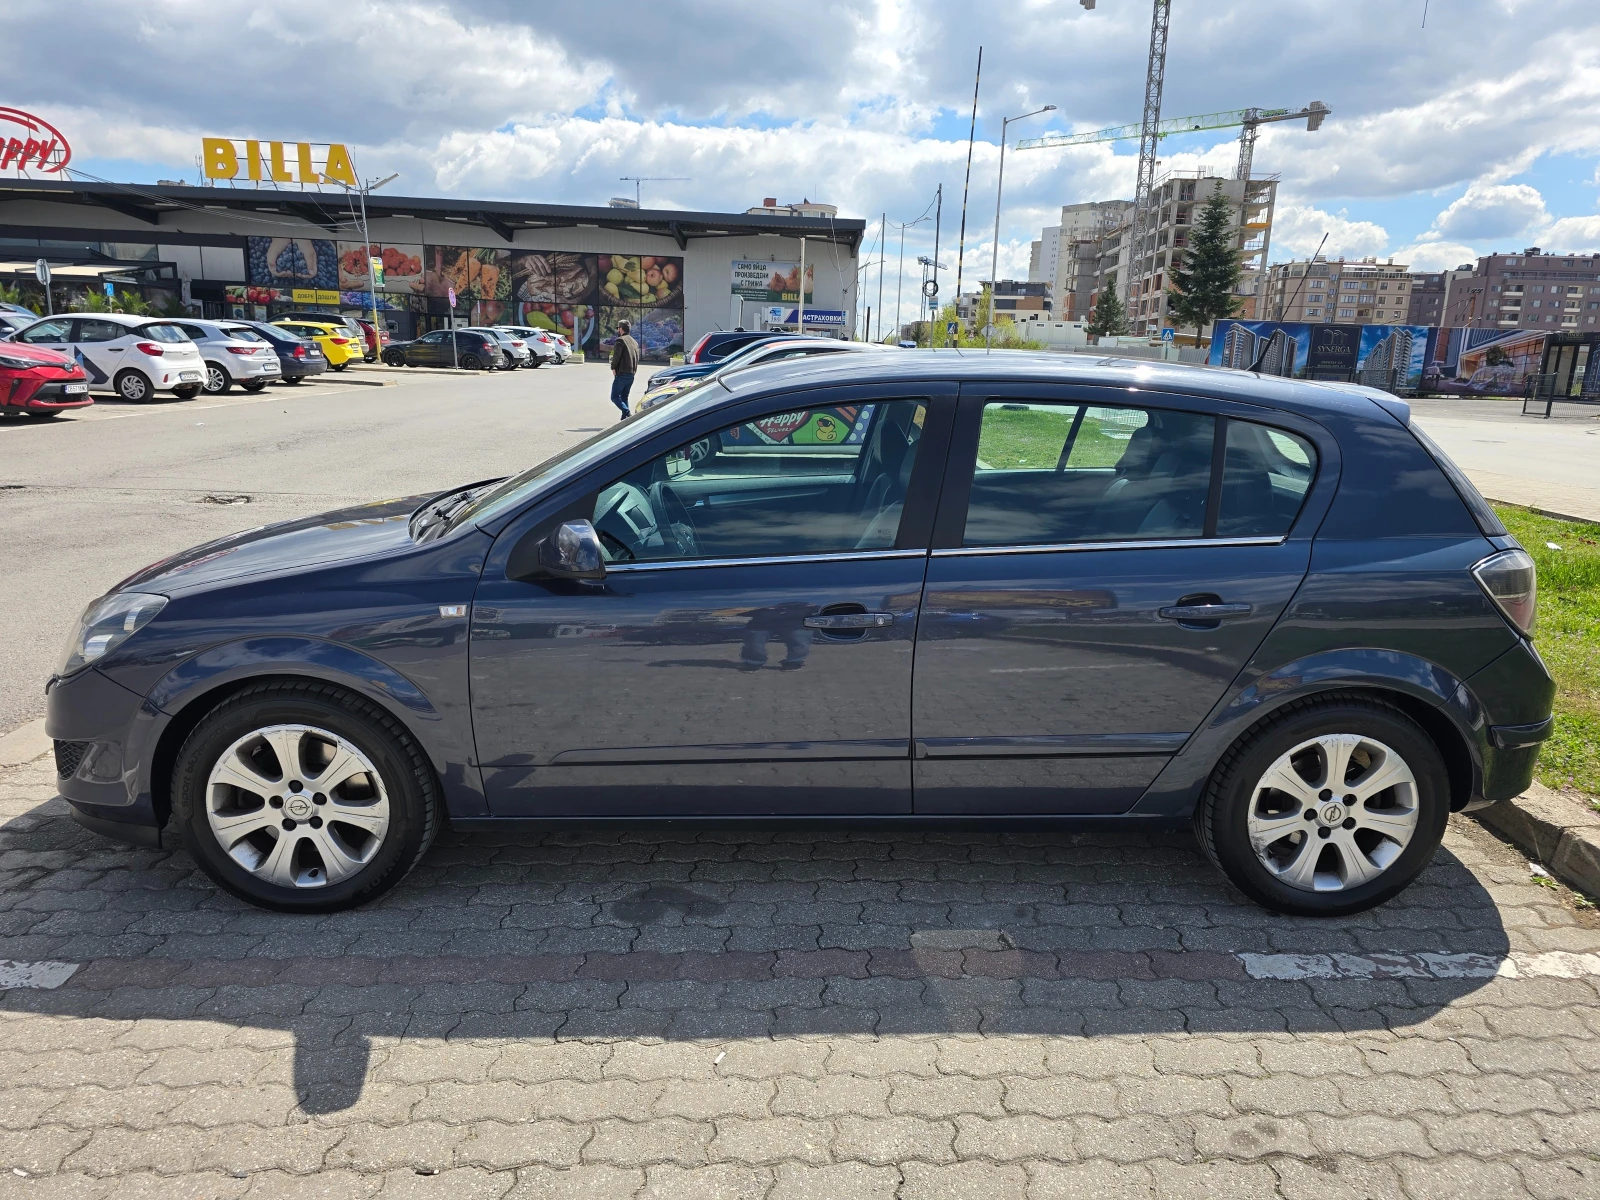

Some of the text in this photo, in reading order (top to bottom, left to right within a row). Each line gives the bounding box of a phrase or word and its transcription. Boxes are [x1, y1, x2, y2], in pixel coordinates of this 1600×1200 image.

[0, 137, 58, 170] ppy
[202, 138, 356, 185] BILLA
[752, 262, 767, 271] ЯЙЦА
[734, 271, 769, 279] ПРОИЗВЕДЕНИ
[1317, 345, 1351, 353] SYNERGA
[760, 411, 806, 427] Happy
